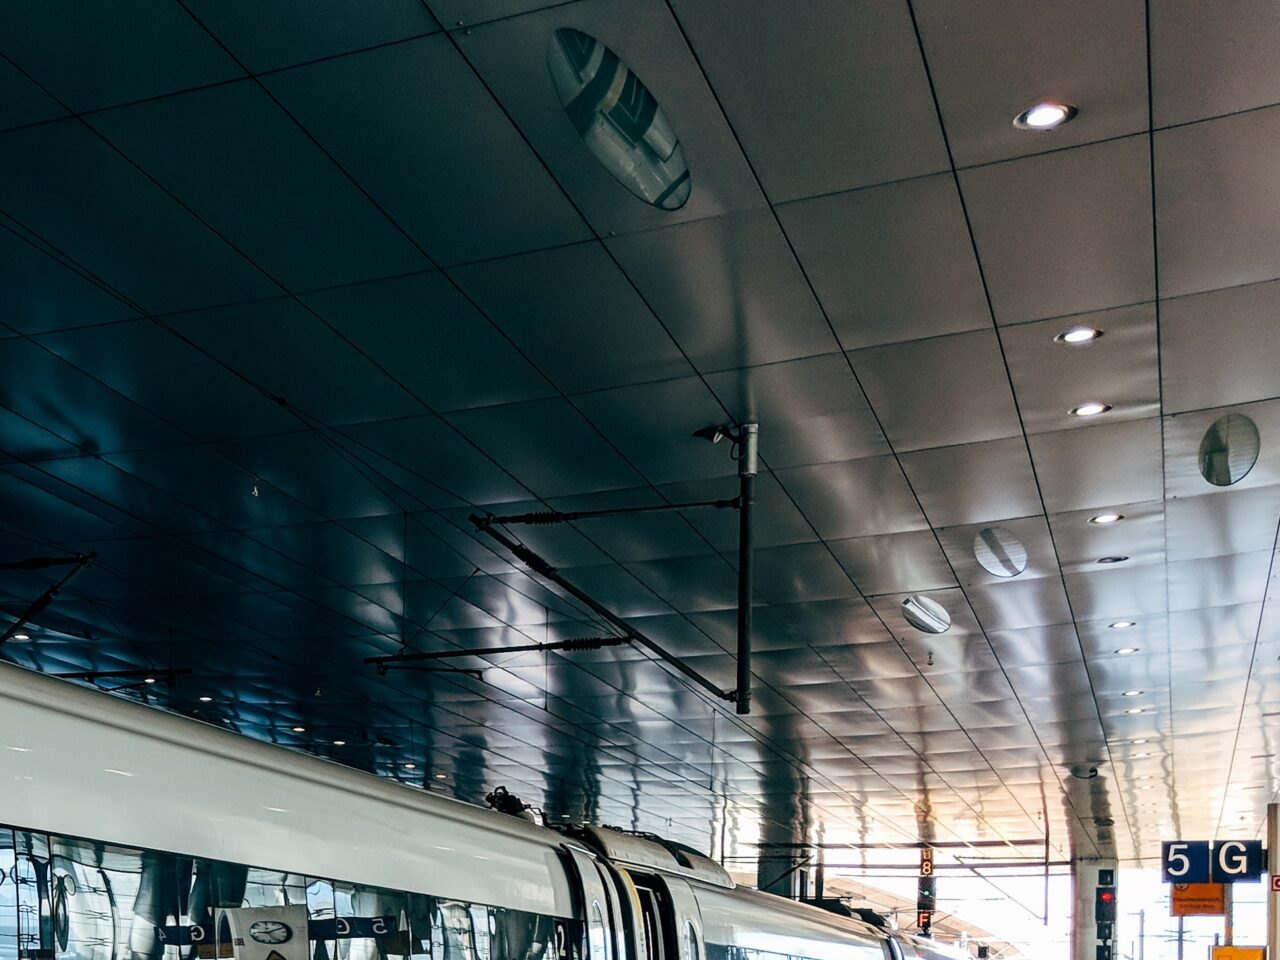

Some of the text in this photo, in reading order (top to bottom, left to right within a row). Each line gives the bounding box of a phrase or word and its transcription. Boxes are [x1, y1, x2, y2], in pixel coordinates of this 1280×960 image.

[1167, 841, 1248, 876] 5 G
[919, 913, 929, 927] F
[557, 924, 567, 957] 2
